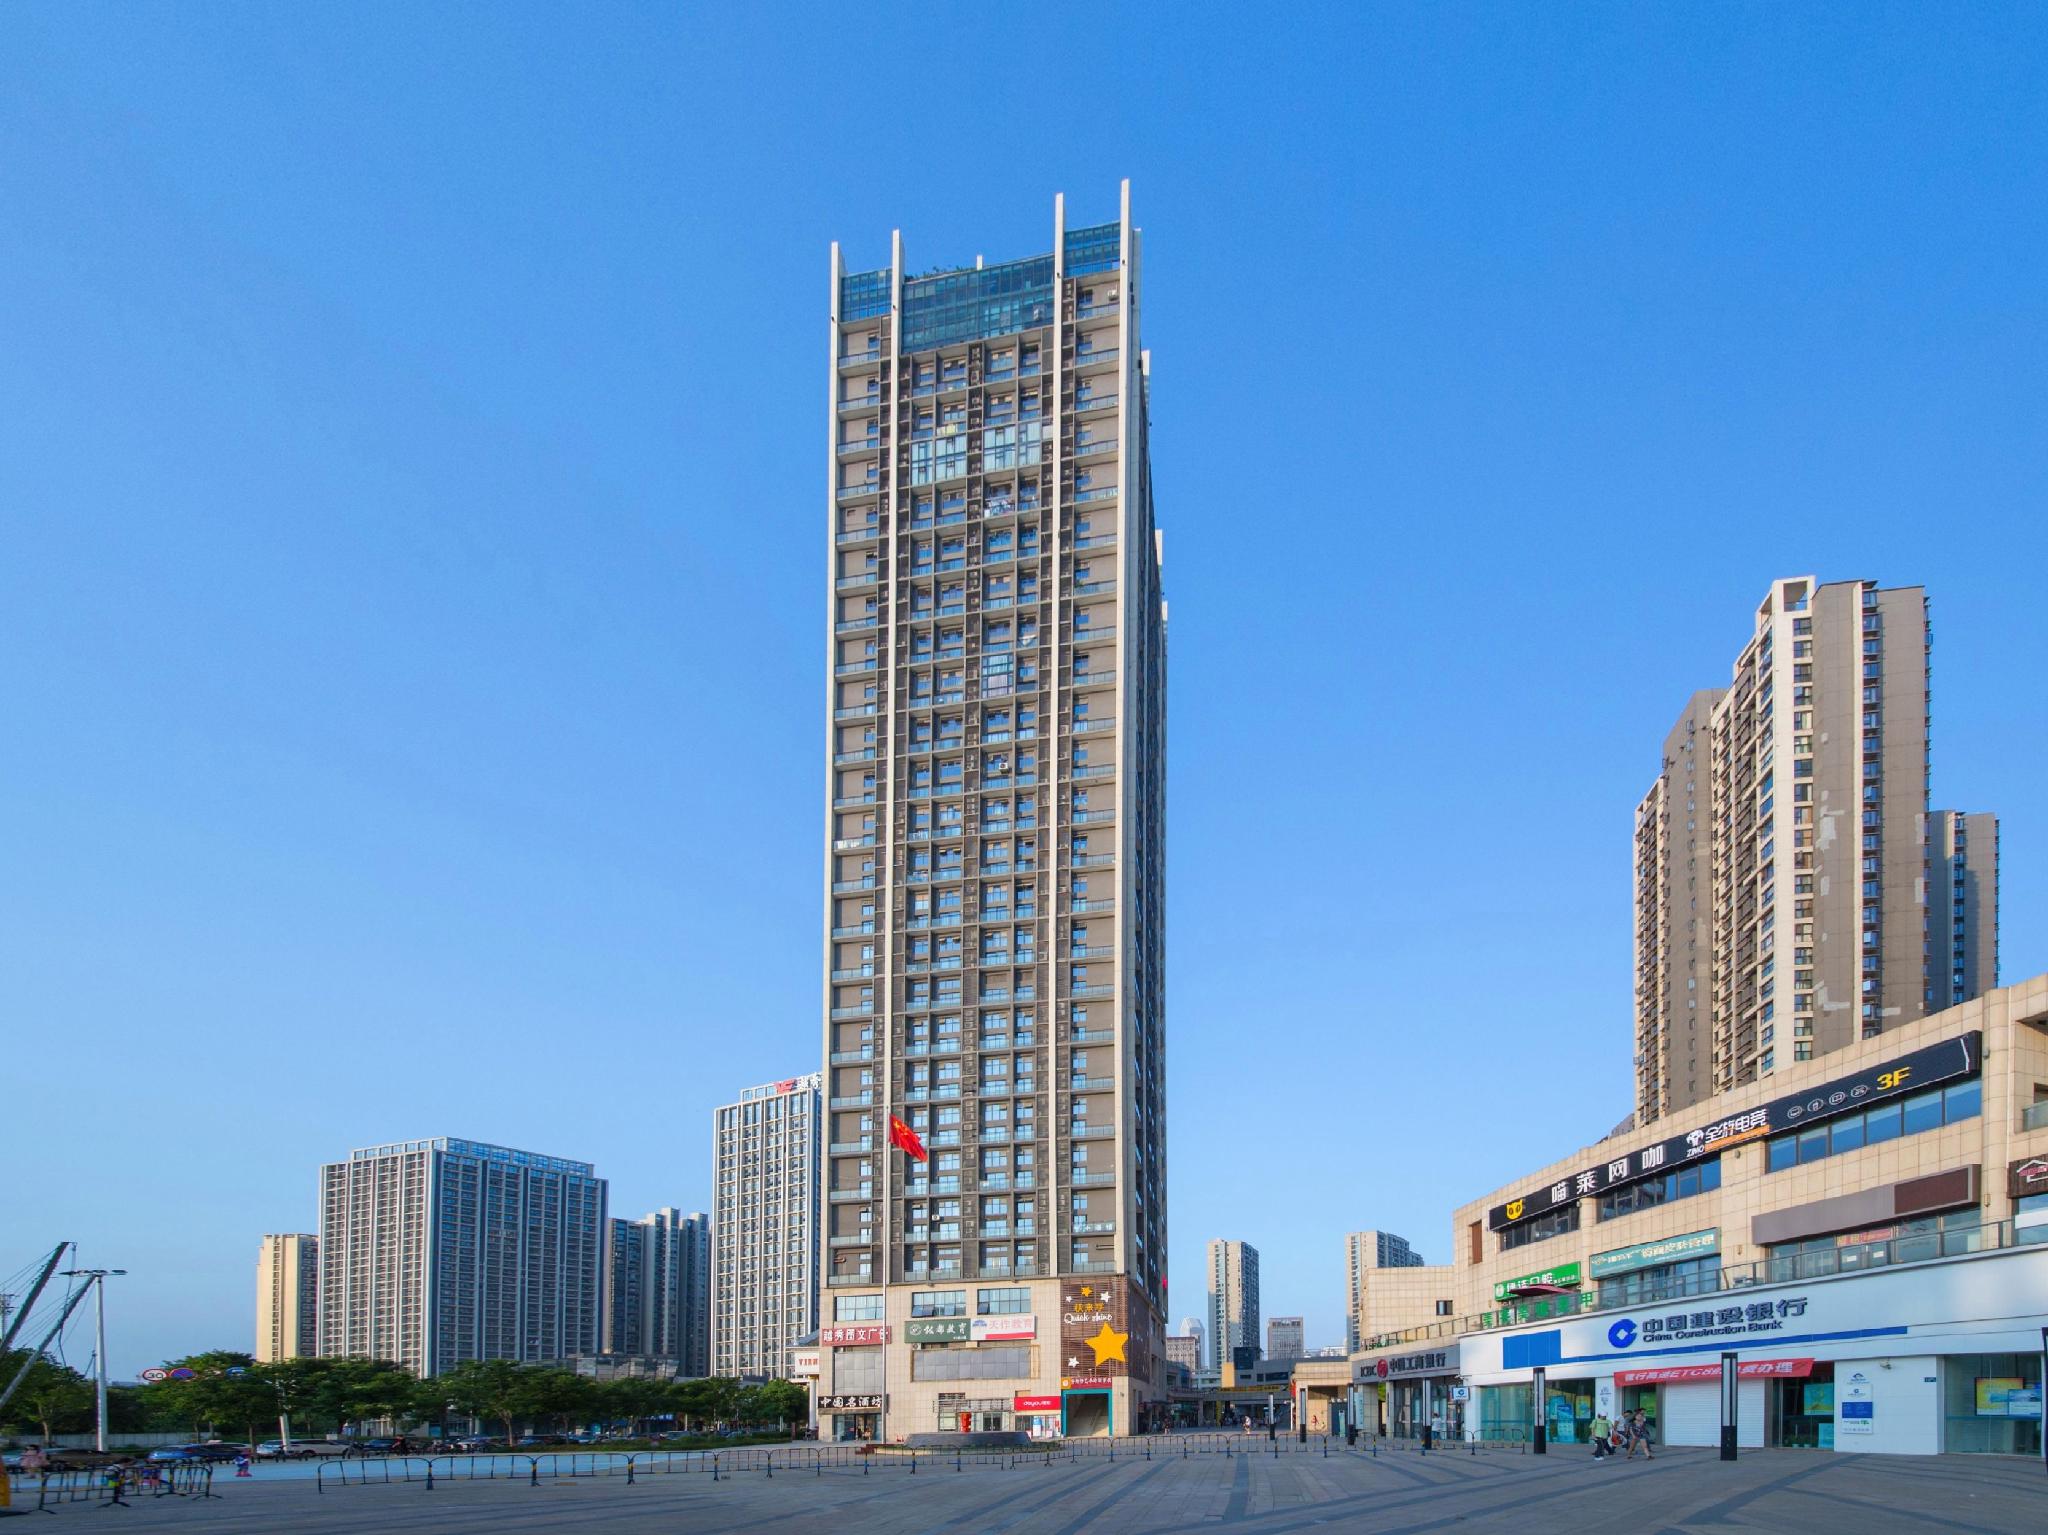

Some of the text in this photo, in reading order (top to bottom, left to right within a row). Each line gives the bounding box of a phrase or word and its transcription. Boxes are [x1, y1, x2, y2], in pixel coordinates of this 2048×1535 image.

[1877, 1066, 1911, 1090] 3F
[1551, 1144, 1665, 1204] 喵莱网咖
[1064, 1312, 1089, 1325] Quick
[1642, 1296, 1808, 1333] 中国建设银行
[1643, 1319, 1783, 1343] China Construction Bank
